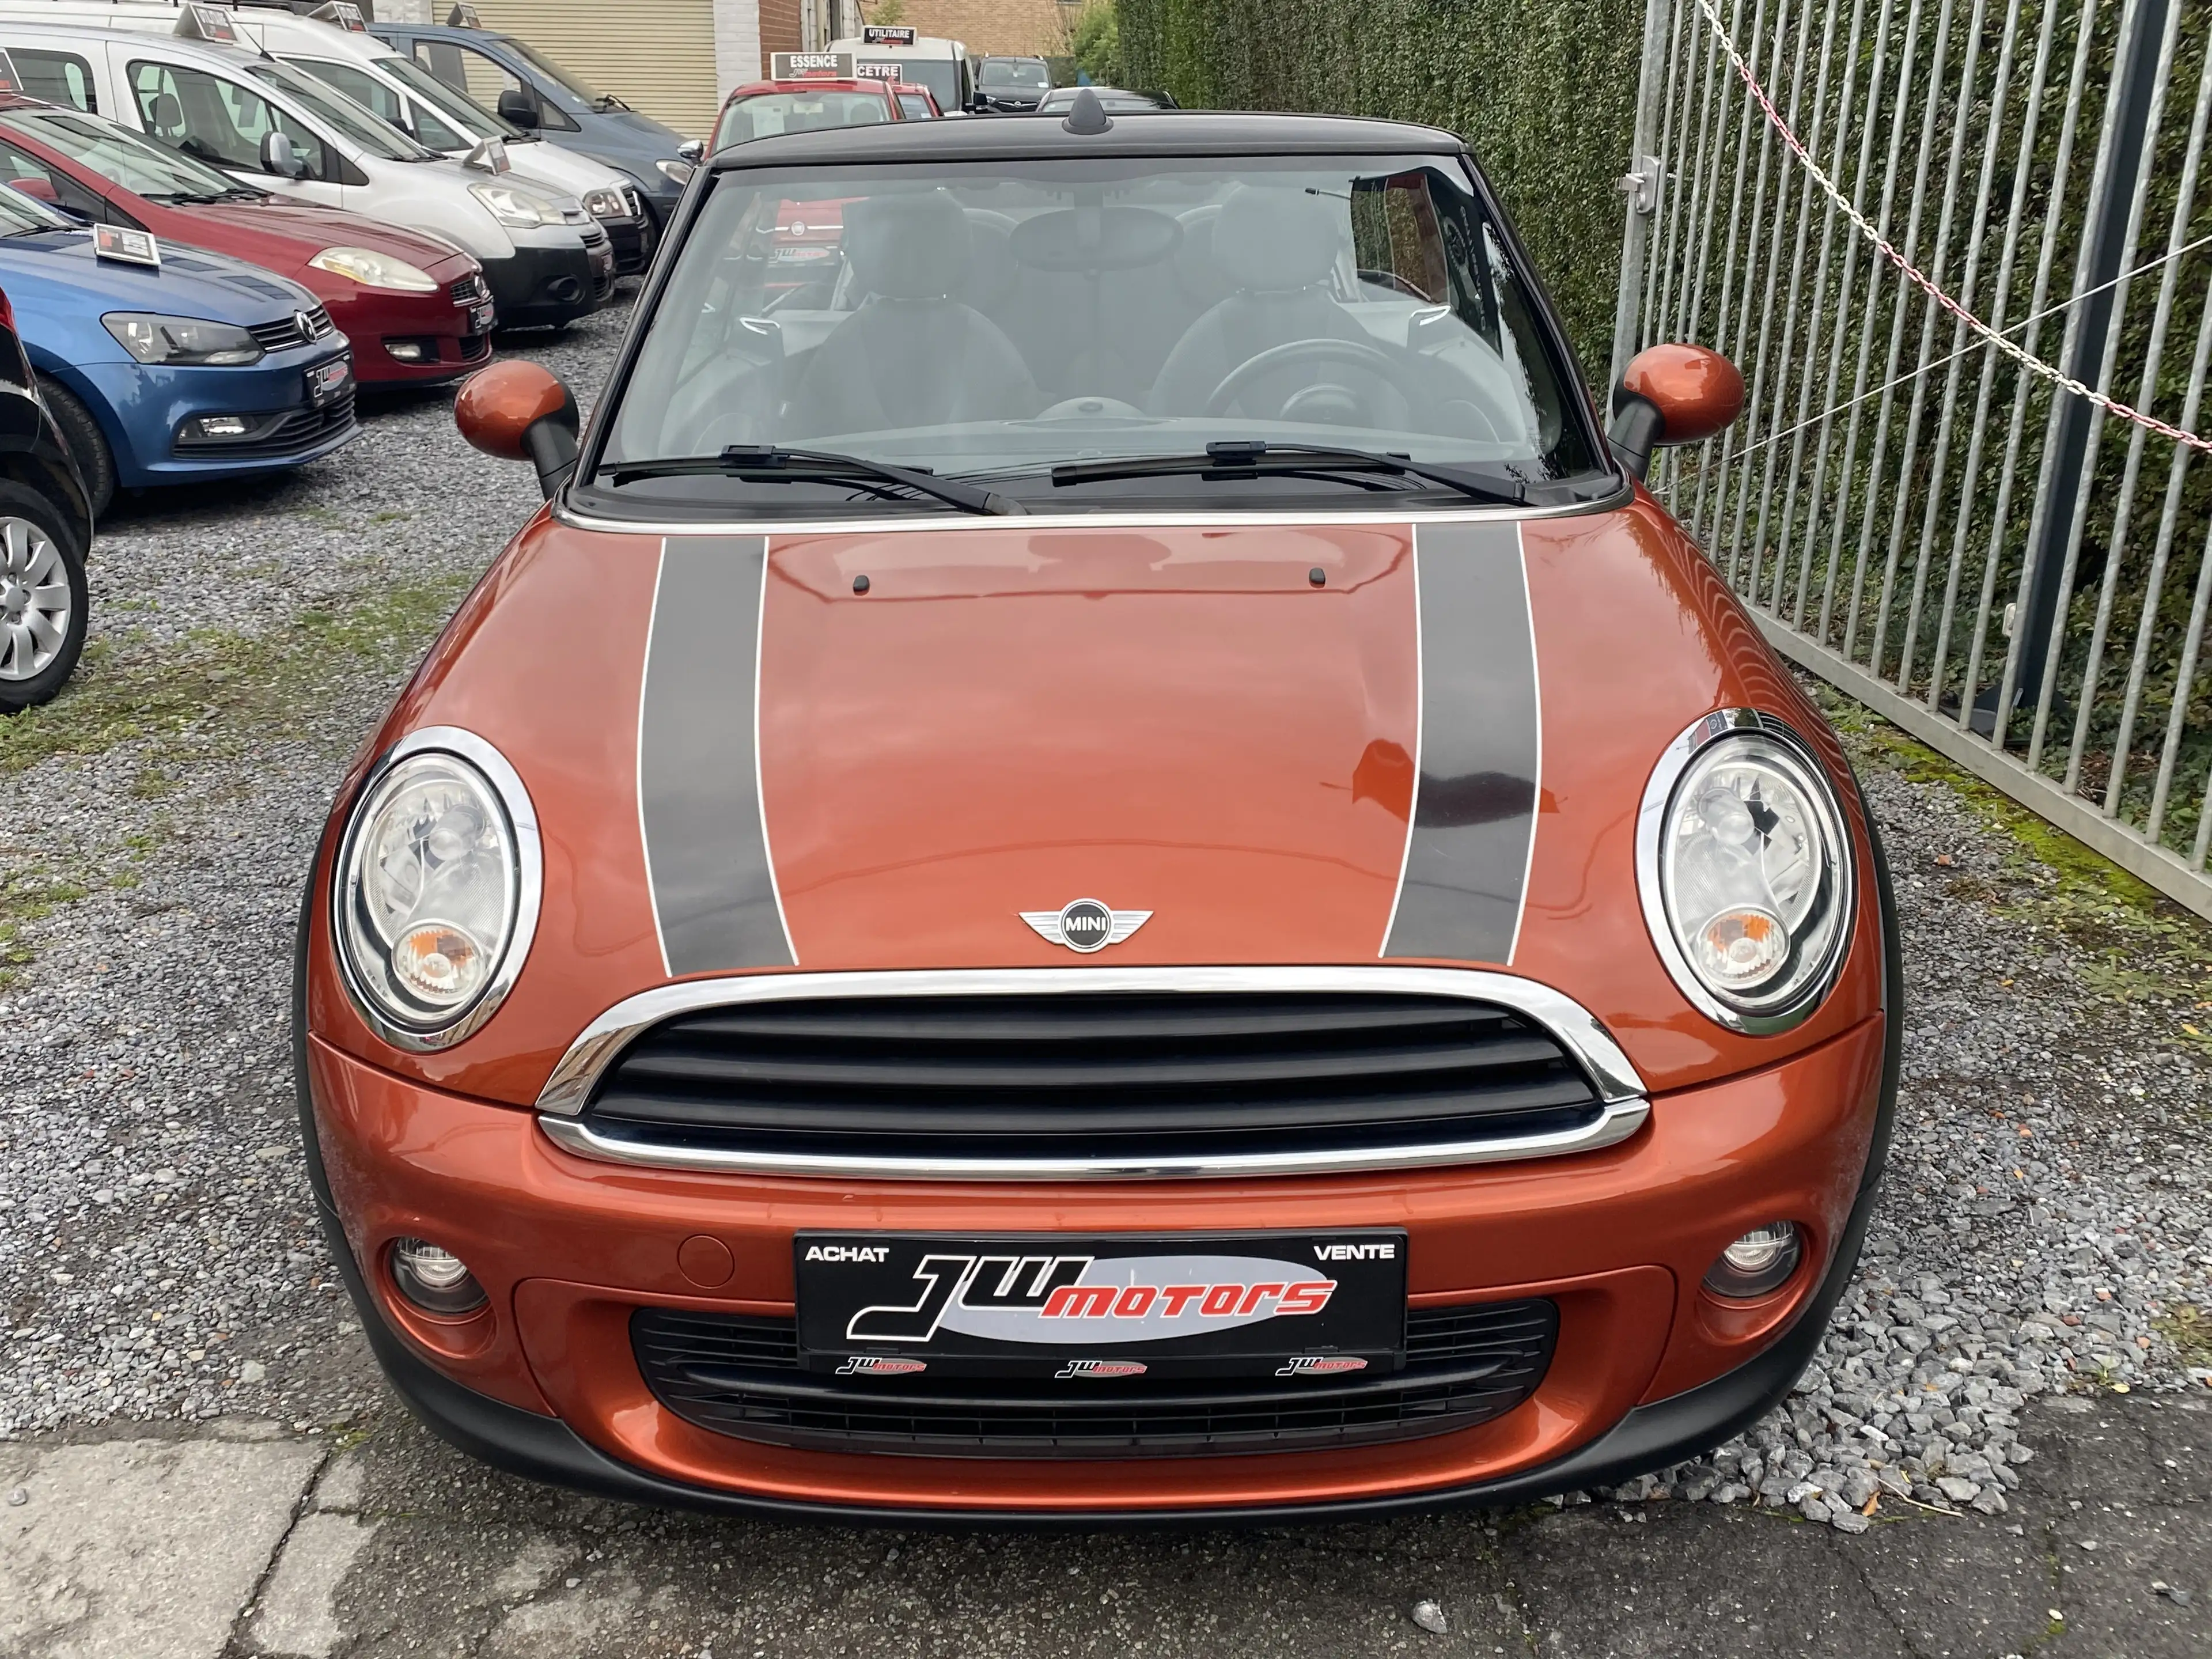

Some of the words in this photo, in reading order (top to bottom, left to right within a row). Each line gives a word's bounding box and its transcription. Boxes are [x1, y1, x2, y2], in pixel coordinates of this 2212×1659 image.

[869, 28, 910, 38] UTILITAIRE
[790, 54, 838, 67] ESSENCE
[1066, 916, 1107, 931] MINI
[805, 1246, 889, 1263] ACHAT
[1313, 1244, 1395, 1260] VENTE
[846, 1254, 1095, 1342] JW
